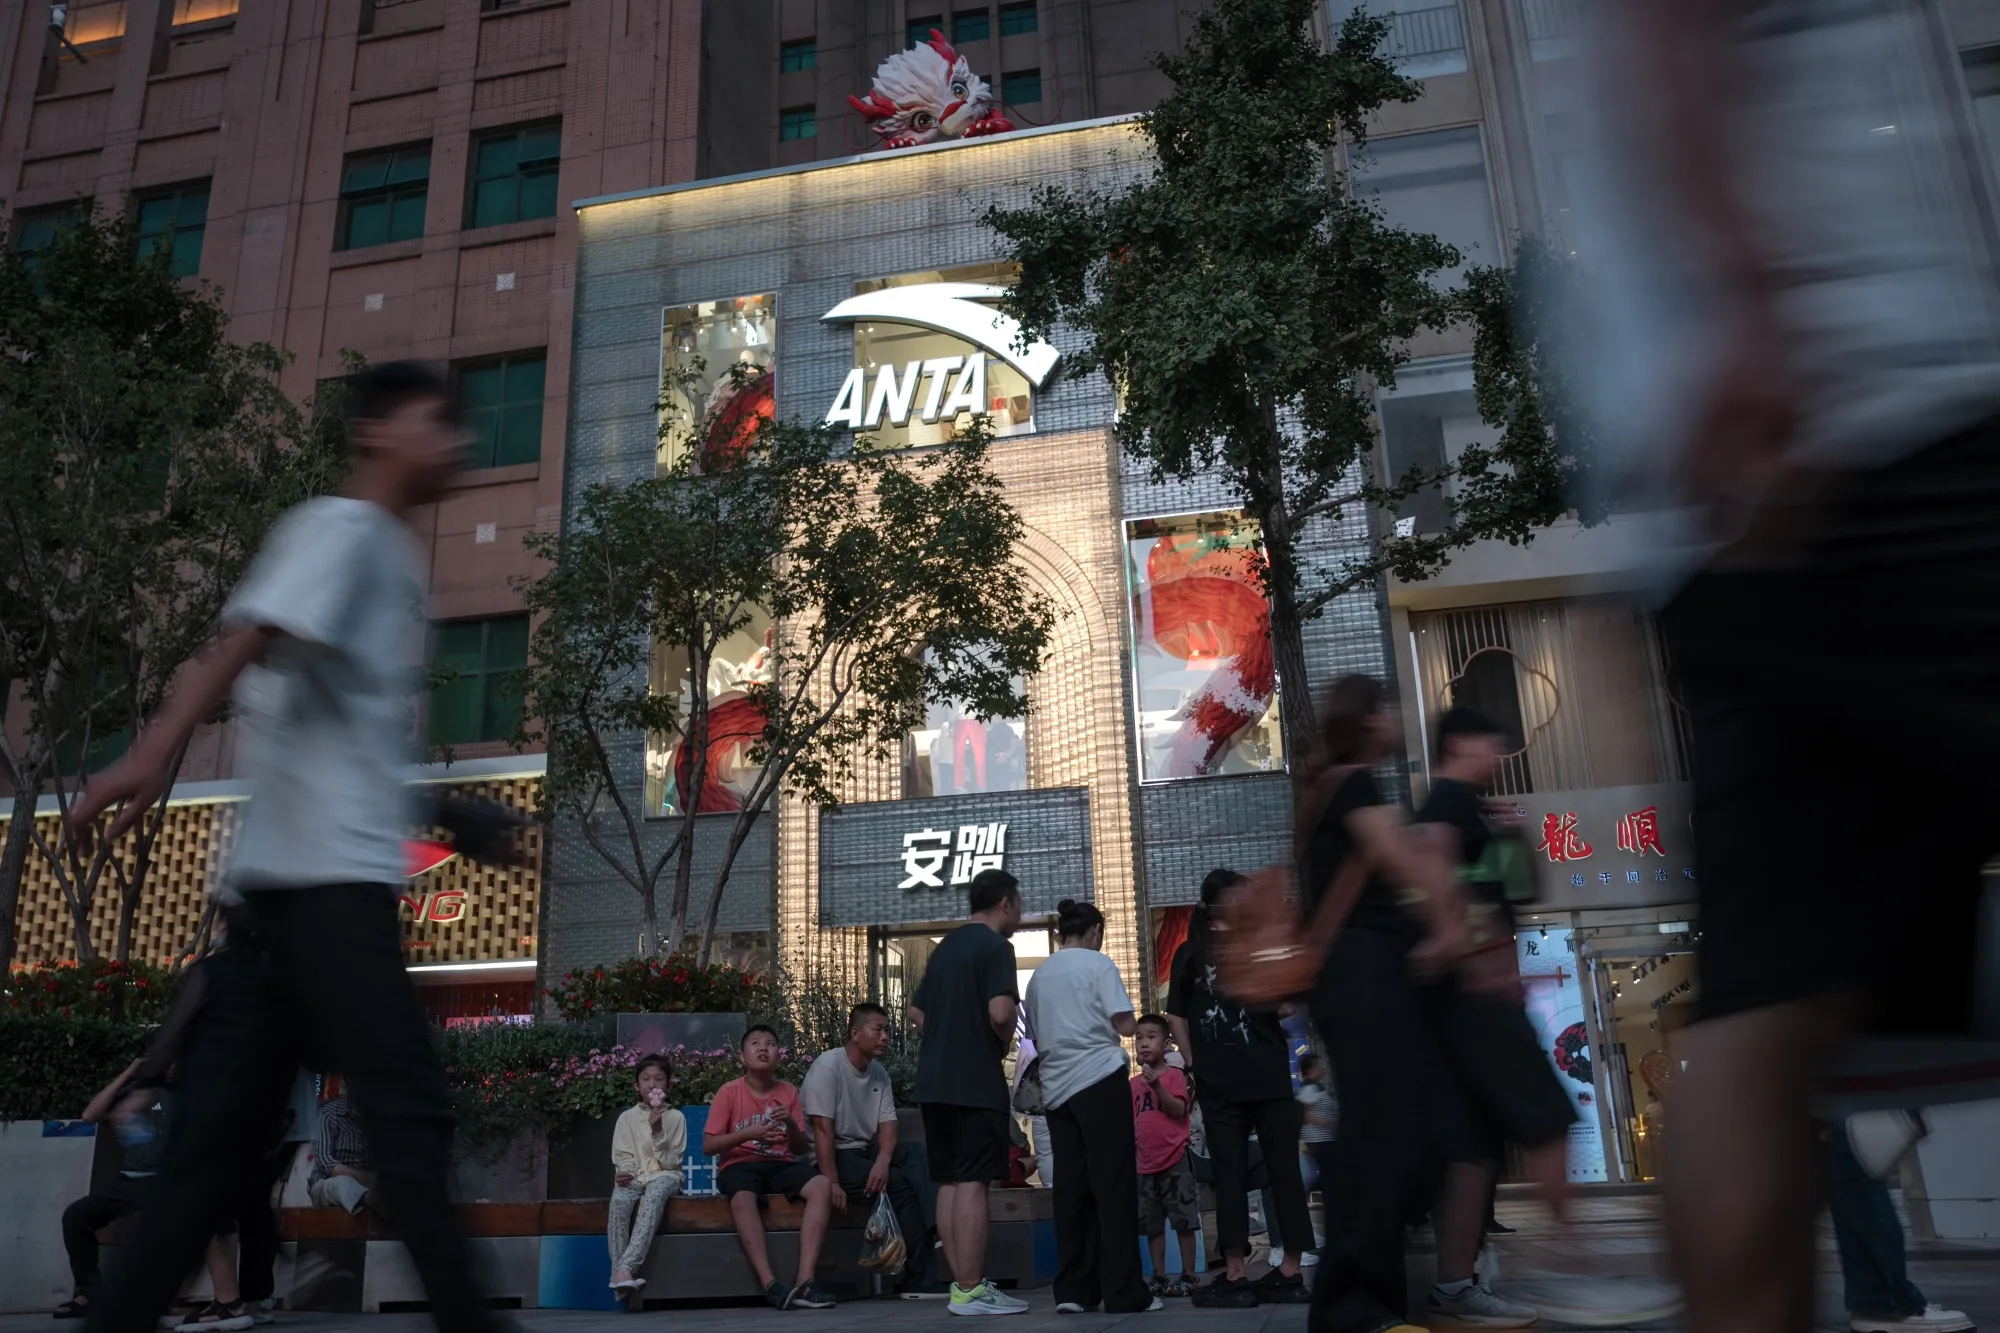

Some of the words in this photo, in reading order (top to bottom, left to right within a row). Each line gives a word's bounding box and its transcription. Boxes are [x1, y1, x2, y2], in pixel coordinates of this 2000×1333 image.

[822, 352, 987, 430] ANTA
[898, 822, 1008, 889] 安踏
[1536, 805, 1696, 863] 龍順
